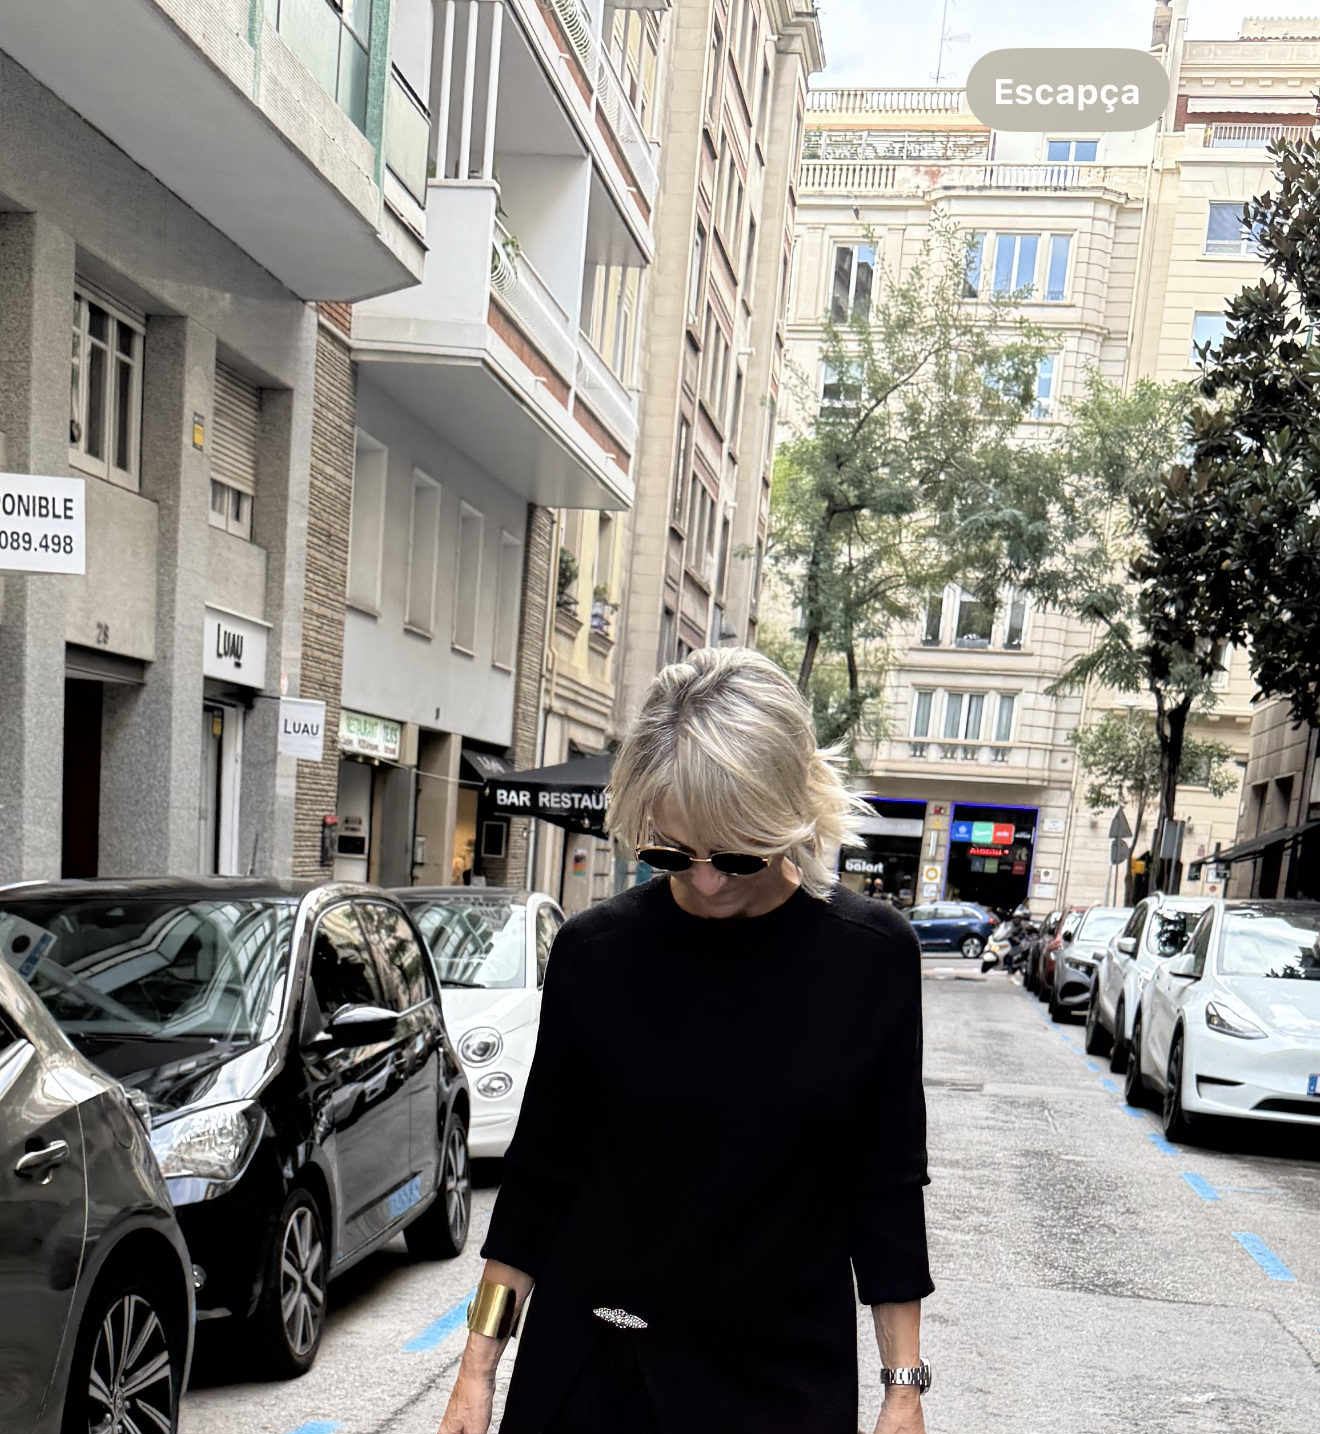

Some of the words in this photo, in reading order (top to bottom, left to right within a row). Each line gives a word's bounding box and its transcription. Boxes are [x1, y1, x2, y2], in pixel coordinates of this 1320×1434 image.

[0, 493, 74, 520] ONIBLE
[0, 530, 74, 554] 089.498
[496, 789, 531, 807] BAR
